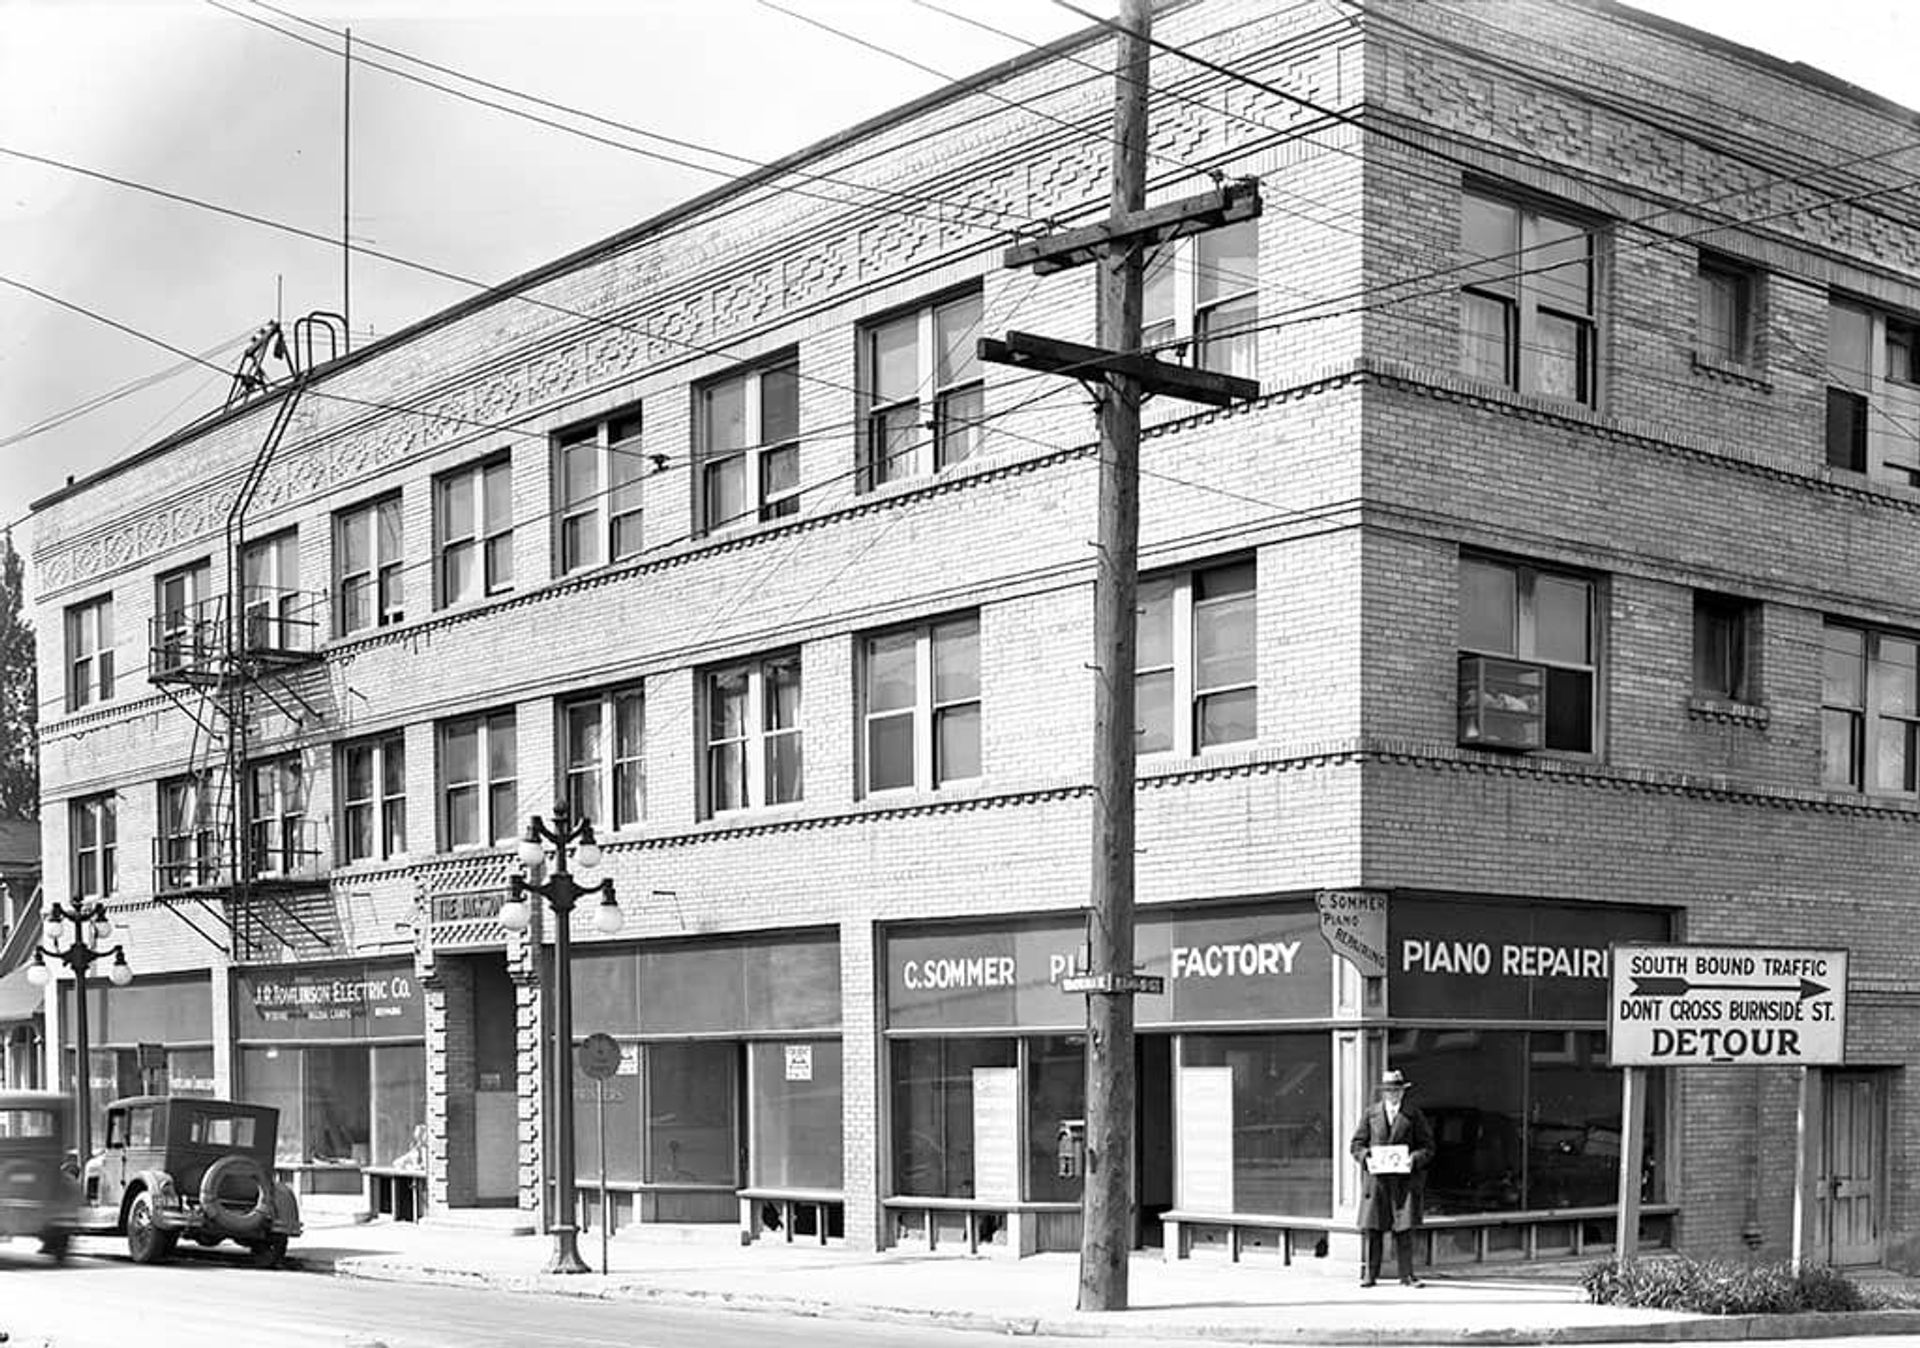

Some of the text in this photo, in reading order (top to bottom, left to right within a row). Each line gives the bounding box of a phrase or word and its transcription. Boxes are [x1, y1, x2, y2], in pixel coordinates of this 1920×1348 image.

[1331, 893, 1386, 911] SOMMER
[1323, 912, 1360, 927] PIANO
[1171, 941, 1301, 979] FACTORY
[1402, 940, 1609, 978] PIANO REPAIRI
[1631, 956, 1828, 977] SOUTH BOUND TRAFFIC
[332, 980, 388, 1003] ELECTRIC
[1620, 1000, 1836, 1022] DONT CROSS BURNSIDE ST.
[1650, 1027, 1802, 1057] DETOUR
